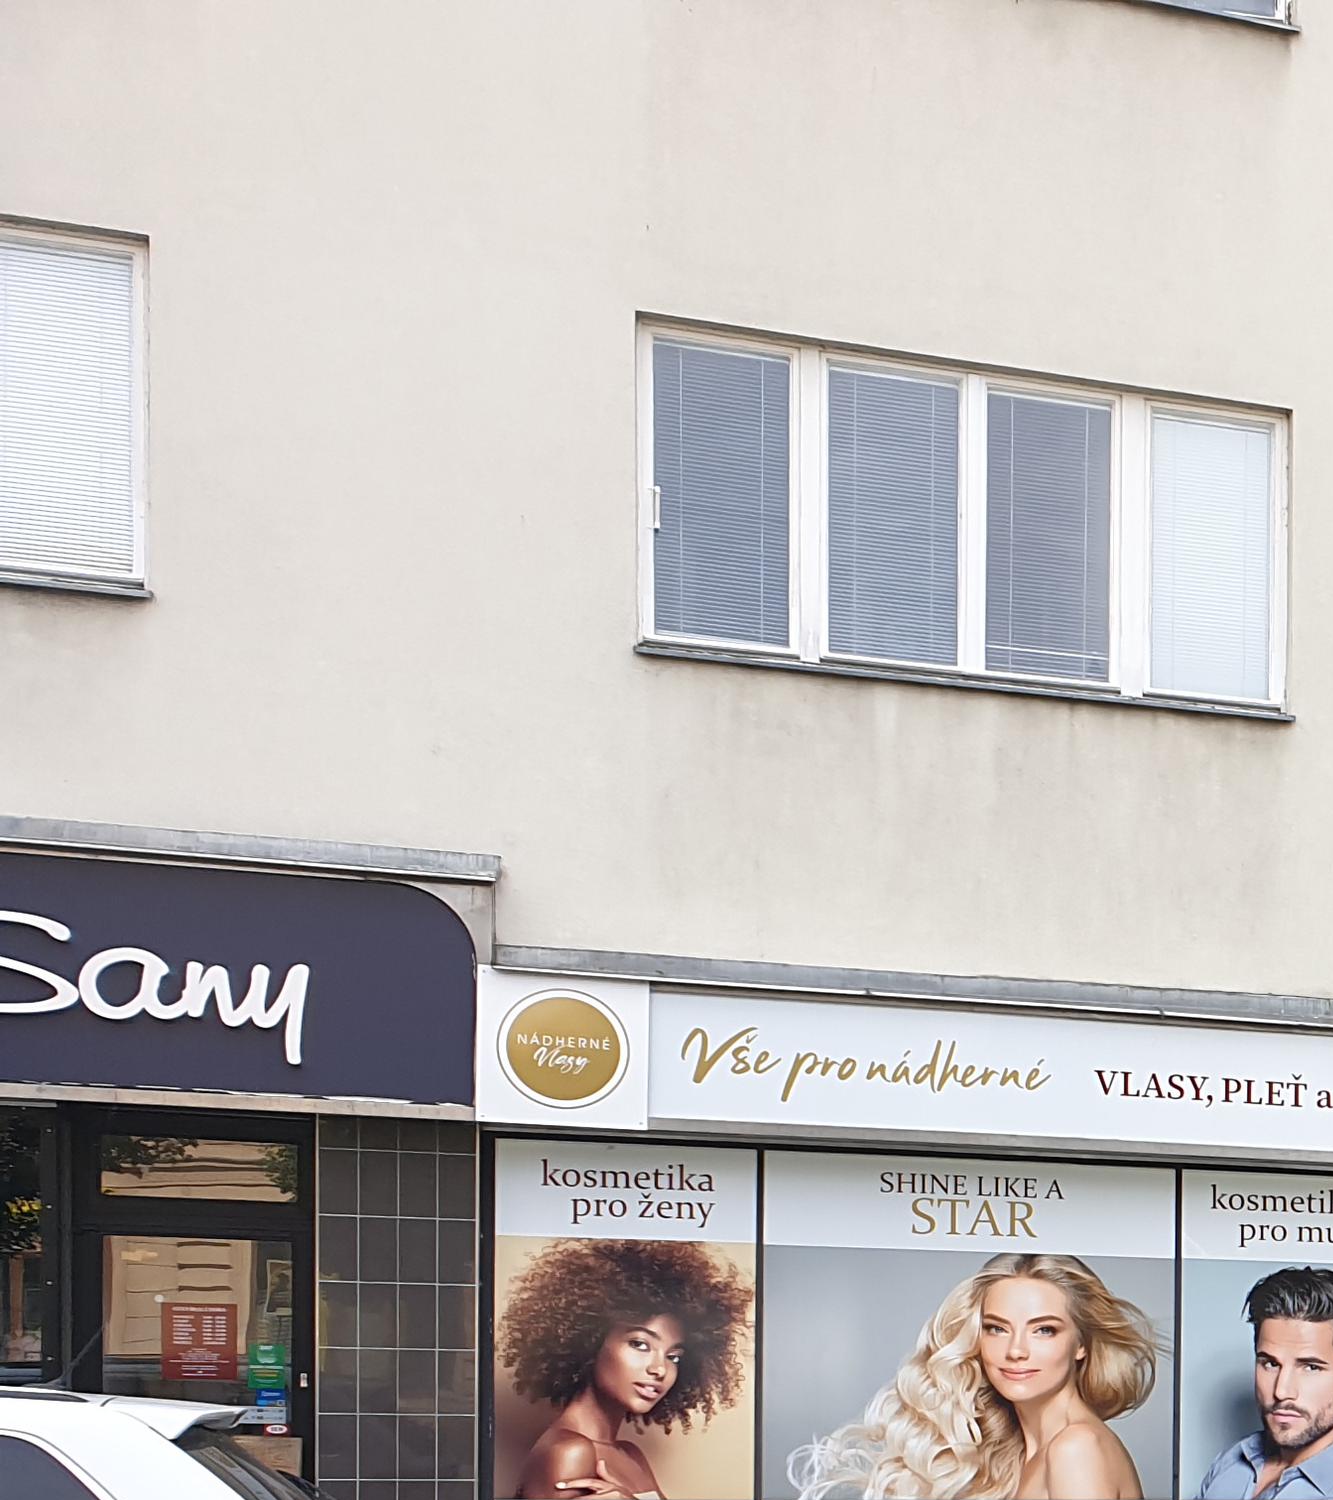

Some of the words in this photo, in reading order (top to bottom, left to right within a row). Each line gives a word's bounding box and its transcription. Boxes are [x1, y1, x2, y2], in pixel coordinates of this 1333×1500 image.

[516, 1031, 612, 1051] NÁDHERNÉ
[680, 1026, 782, 1084] Vše
[780, 1051, 857, 1103] pro
[865, 1039, 1052, 1094] nádherné
[1094, 1069, 1213, 1108] VLASY,
[1221, 1073, 1308, 1108] PLEŤ
[1316, 1088, 1333, 1109] a
[540, 1159, 716, 1193] kosmetika
[879, 1171, 968, 1196] SHINE
[977, 1175, 1038, 1199] LIKE
[1045, 1177, 1065, 1200] A
[570, 1197, 628, 1225] pro
[637, 1193, 717, 1228] ženy
[910, 1197, 1038, 1239] STAR
[1238, 1223, 1288, 1248] pro
